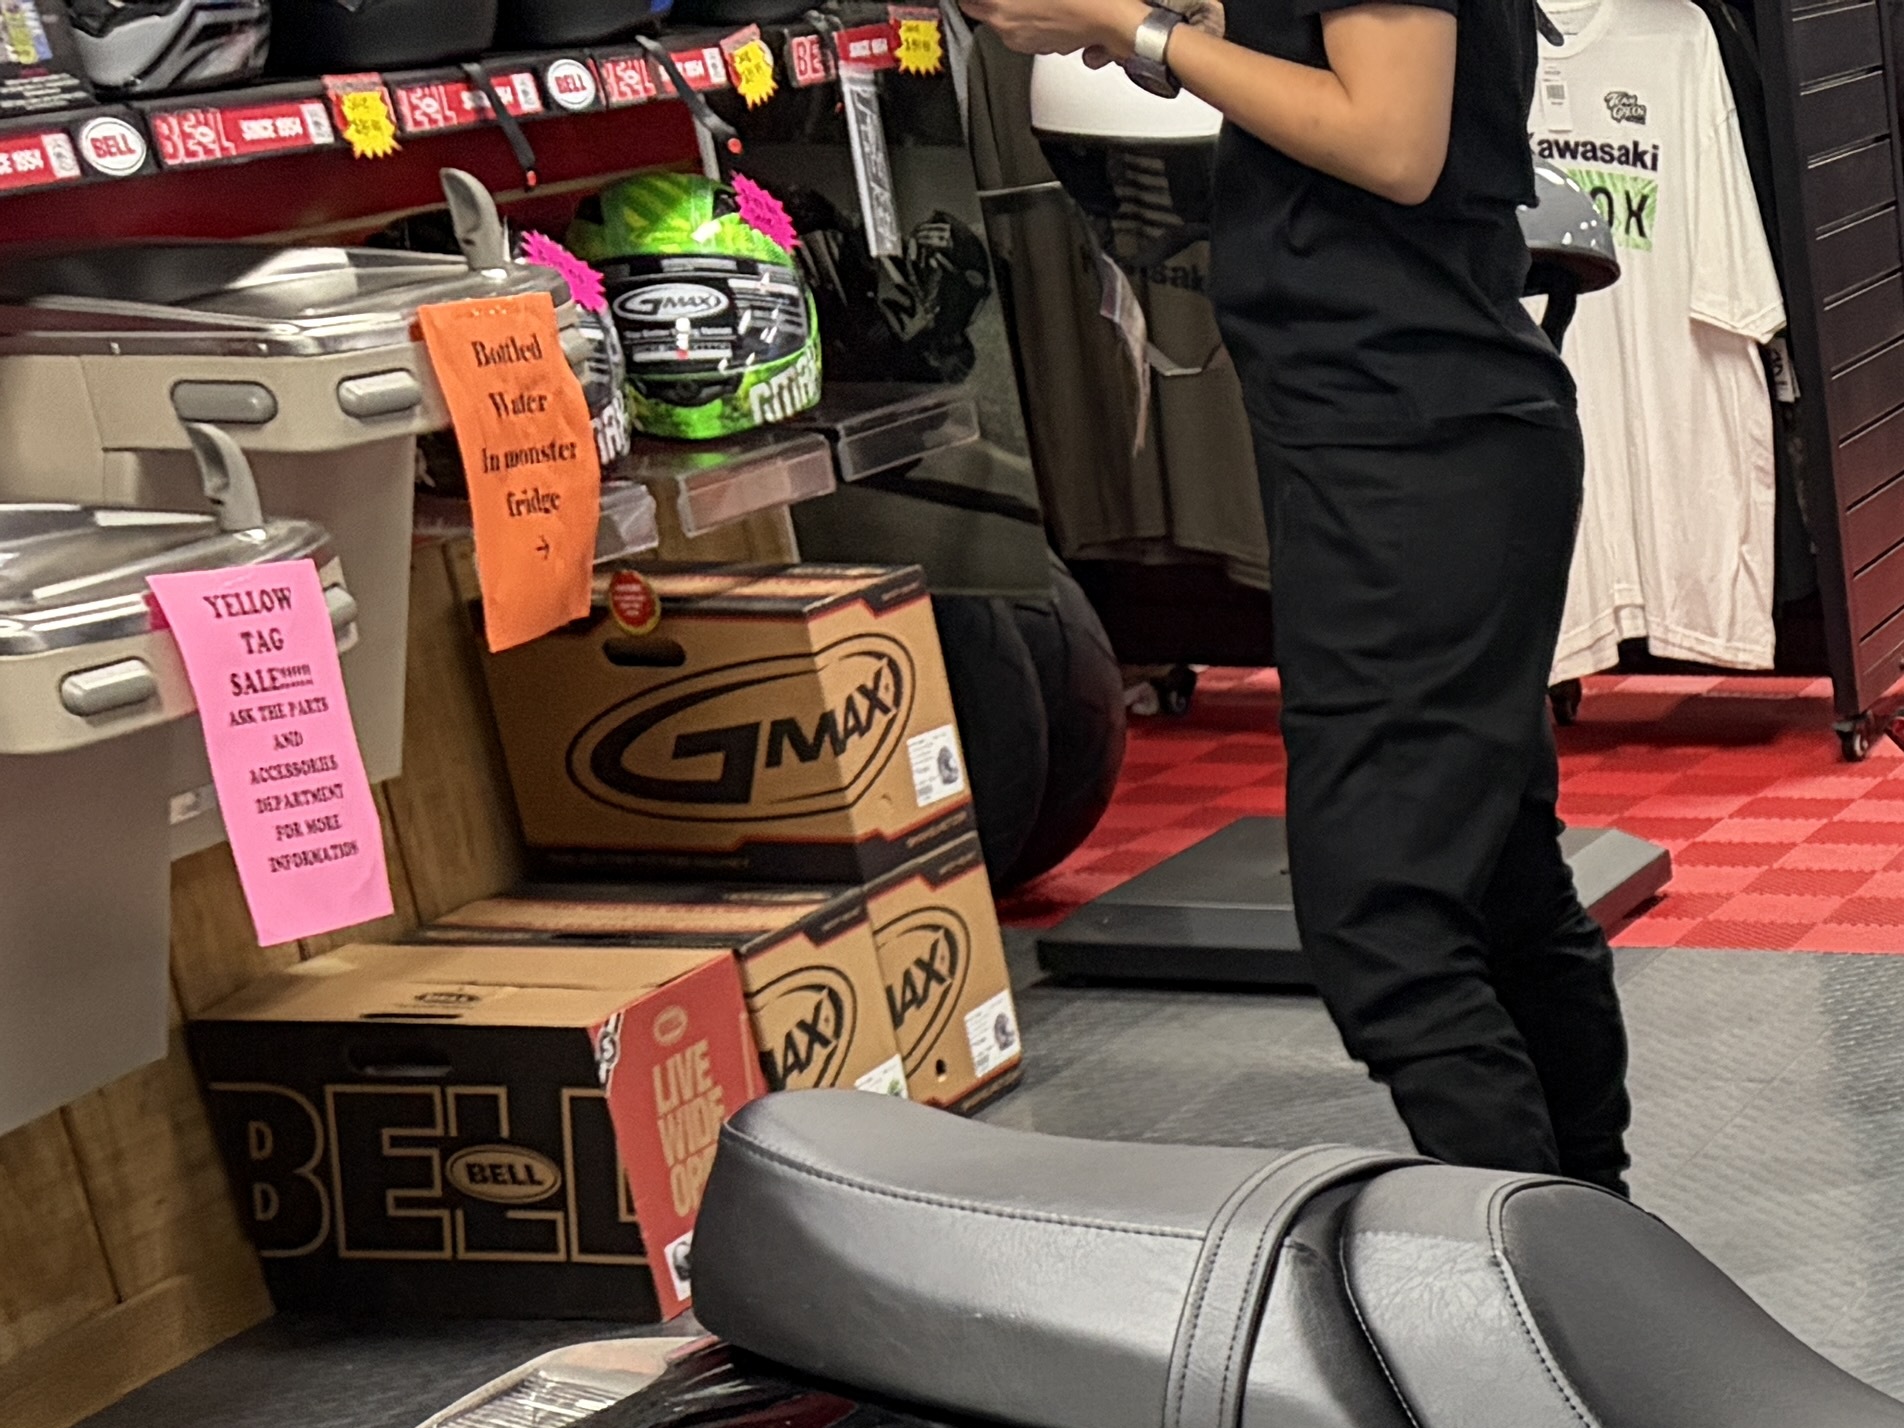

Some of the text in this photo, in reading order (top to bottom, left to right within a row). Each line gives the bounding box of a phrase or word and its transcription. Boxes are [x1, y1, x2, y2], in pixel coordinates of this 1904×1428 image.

[555, 74, 587, 94] BELL
[91, 134, 136, 157] BELL
[622, 289, 717, 317] GMAX
[471, 333, 543, 367] Bottled
[489, 392, 547, 418] Water
[504, 441, 577, 469] monster
[506, 488, 561, 517] fridge
[203, 587, 292, 619] YELLOW
[240, 628, 284, 655] TAG
[230, 697, 329, 726] ASK THE PARTS
[273, 731, 303, 750] AND
[590, 652, 901, 804] GMAX
[250, 754, 339, 785] ACCESSORIES
[256, 783, 344, 814] DEPARTMENT
[276, 814, 342, 841] FOR MORE
[269, 841, 359, 873] INFORMATION
[652, 1038, 714, 1118] LIVE
[657, 1085, 726, 1169] WIDE
[209, 1082, 650, 1265] BELL
[465, 1161, 545, 1188] BELL
[670, 1143, 719, 1218] OP
